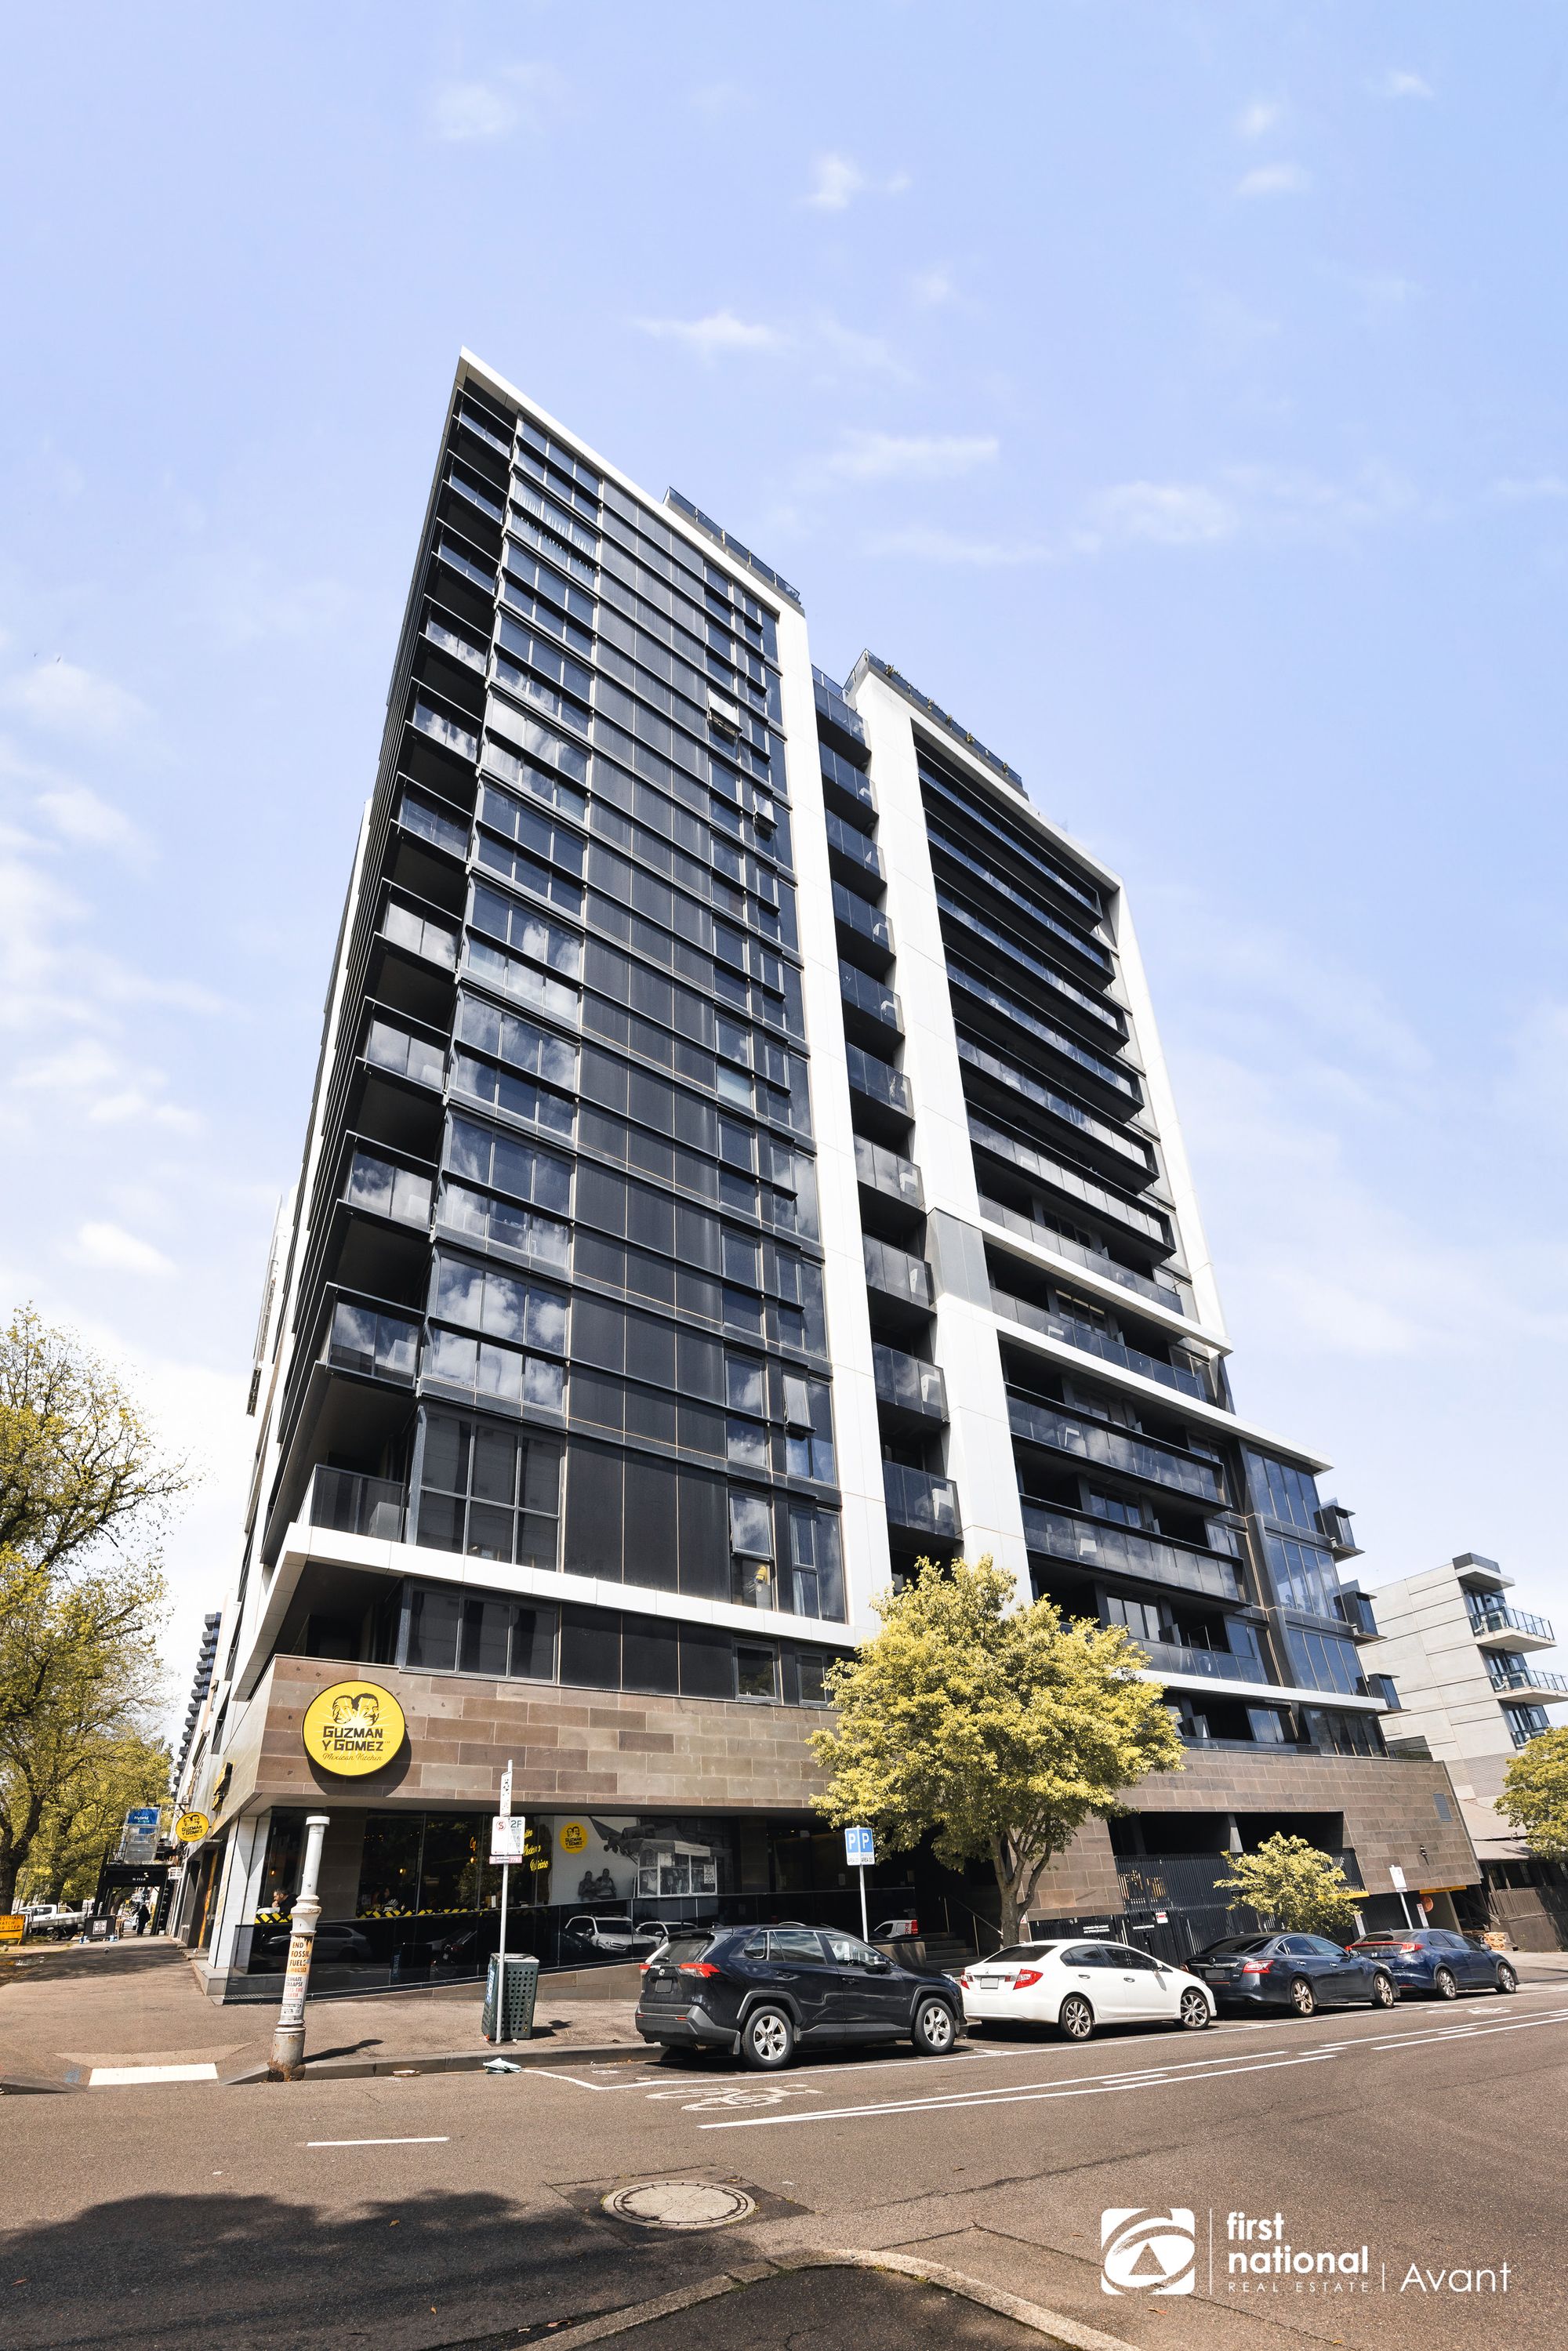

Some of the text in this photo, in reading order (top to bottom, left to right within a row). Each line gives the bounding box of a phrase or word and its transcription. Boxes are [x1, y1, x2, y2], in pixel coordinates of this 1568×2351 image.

[323, 1726, 383, 1738] GUZMAN
[322, 1740, 383, 1751] Y GOMEZ
[356, 1753, 382, 1761] Kitchen
[848, 1832, 869, 1850] P P
